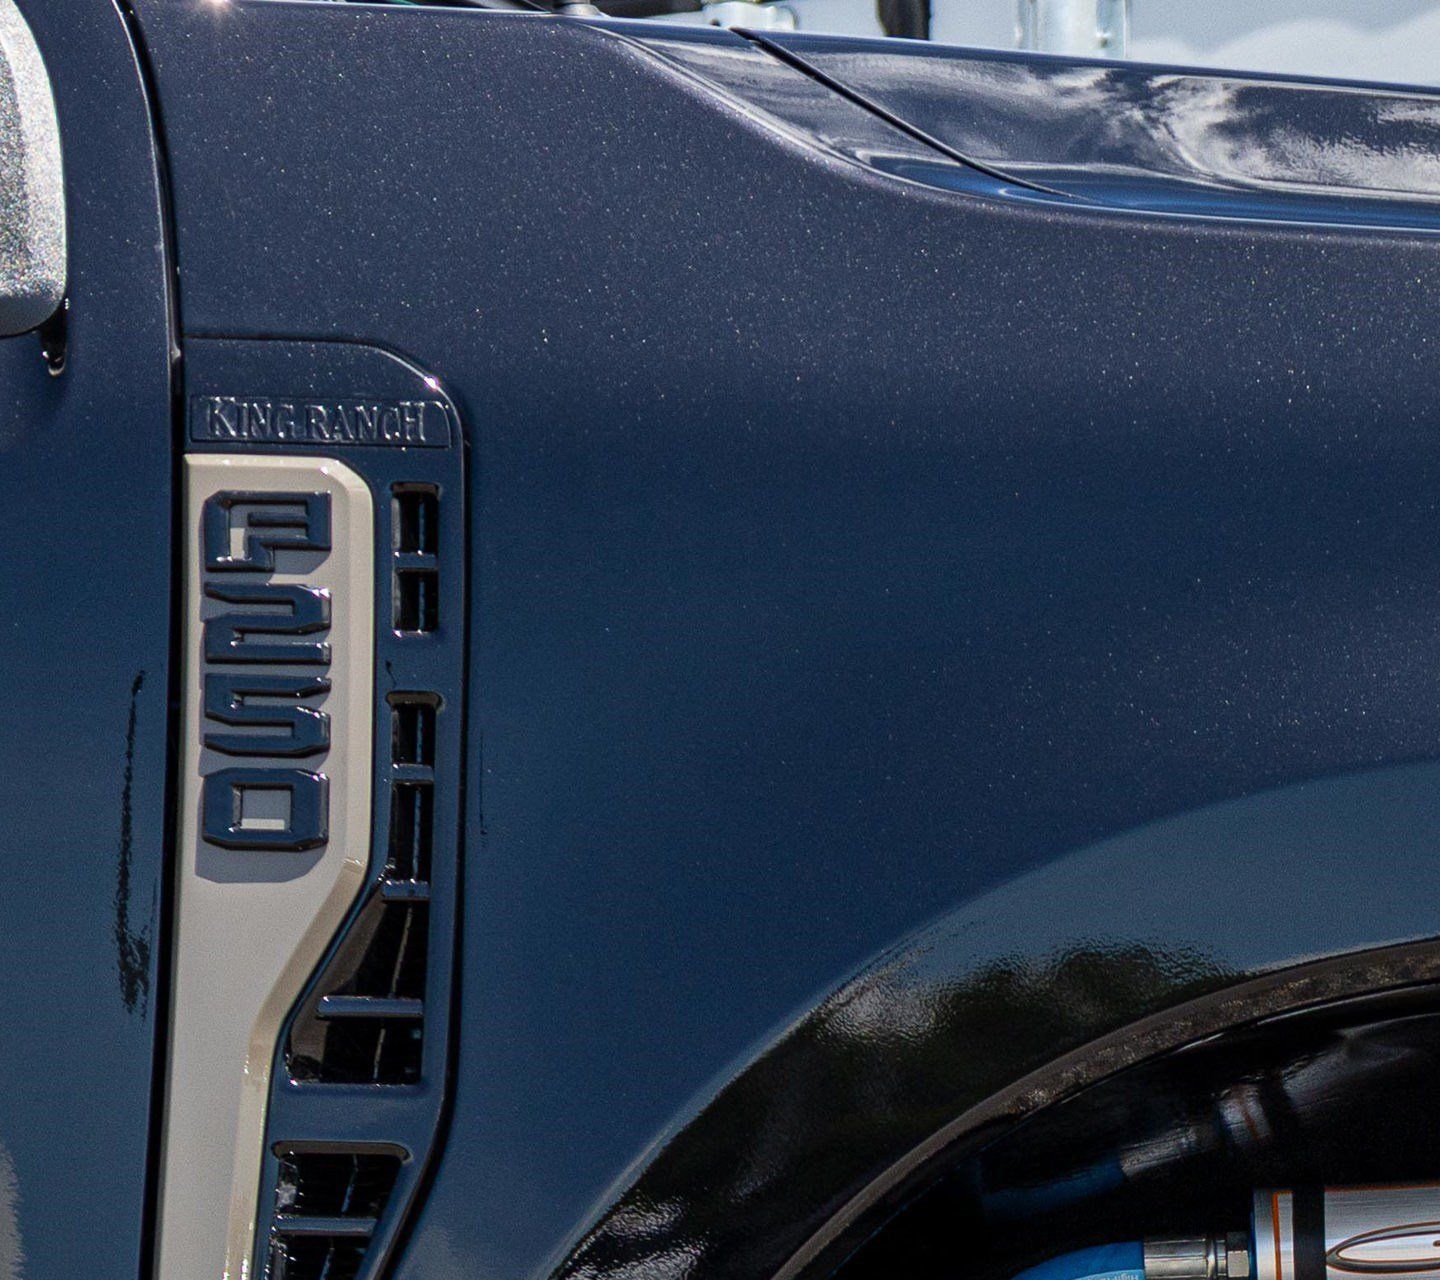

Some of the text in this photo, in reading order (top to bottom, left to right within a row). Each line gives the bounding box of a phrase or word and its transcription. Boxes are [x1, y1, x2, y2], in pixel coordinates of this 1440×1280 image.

[209, 396, 426, 442] KING RANCH
[201, 489, 333, 852] F250
